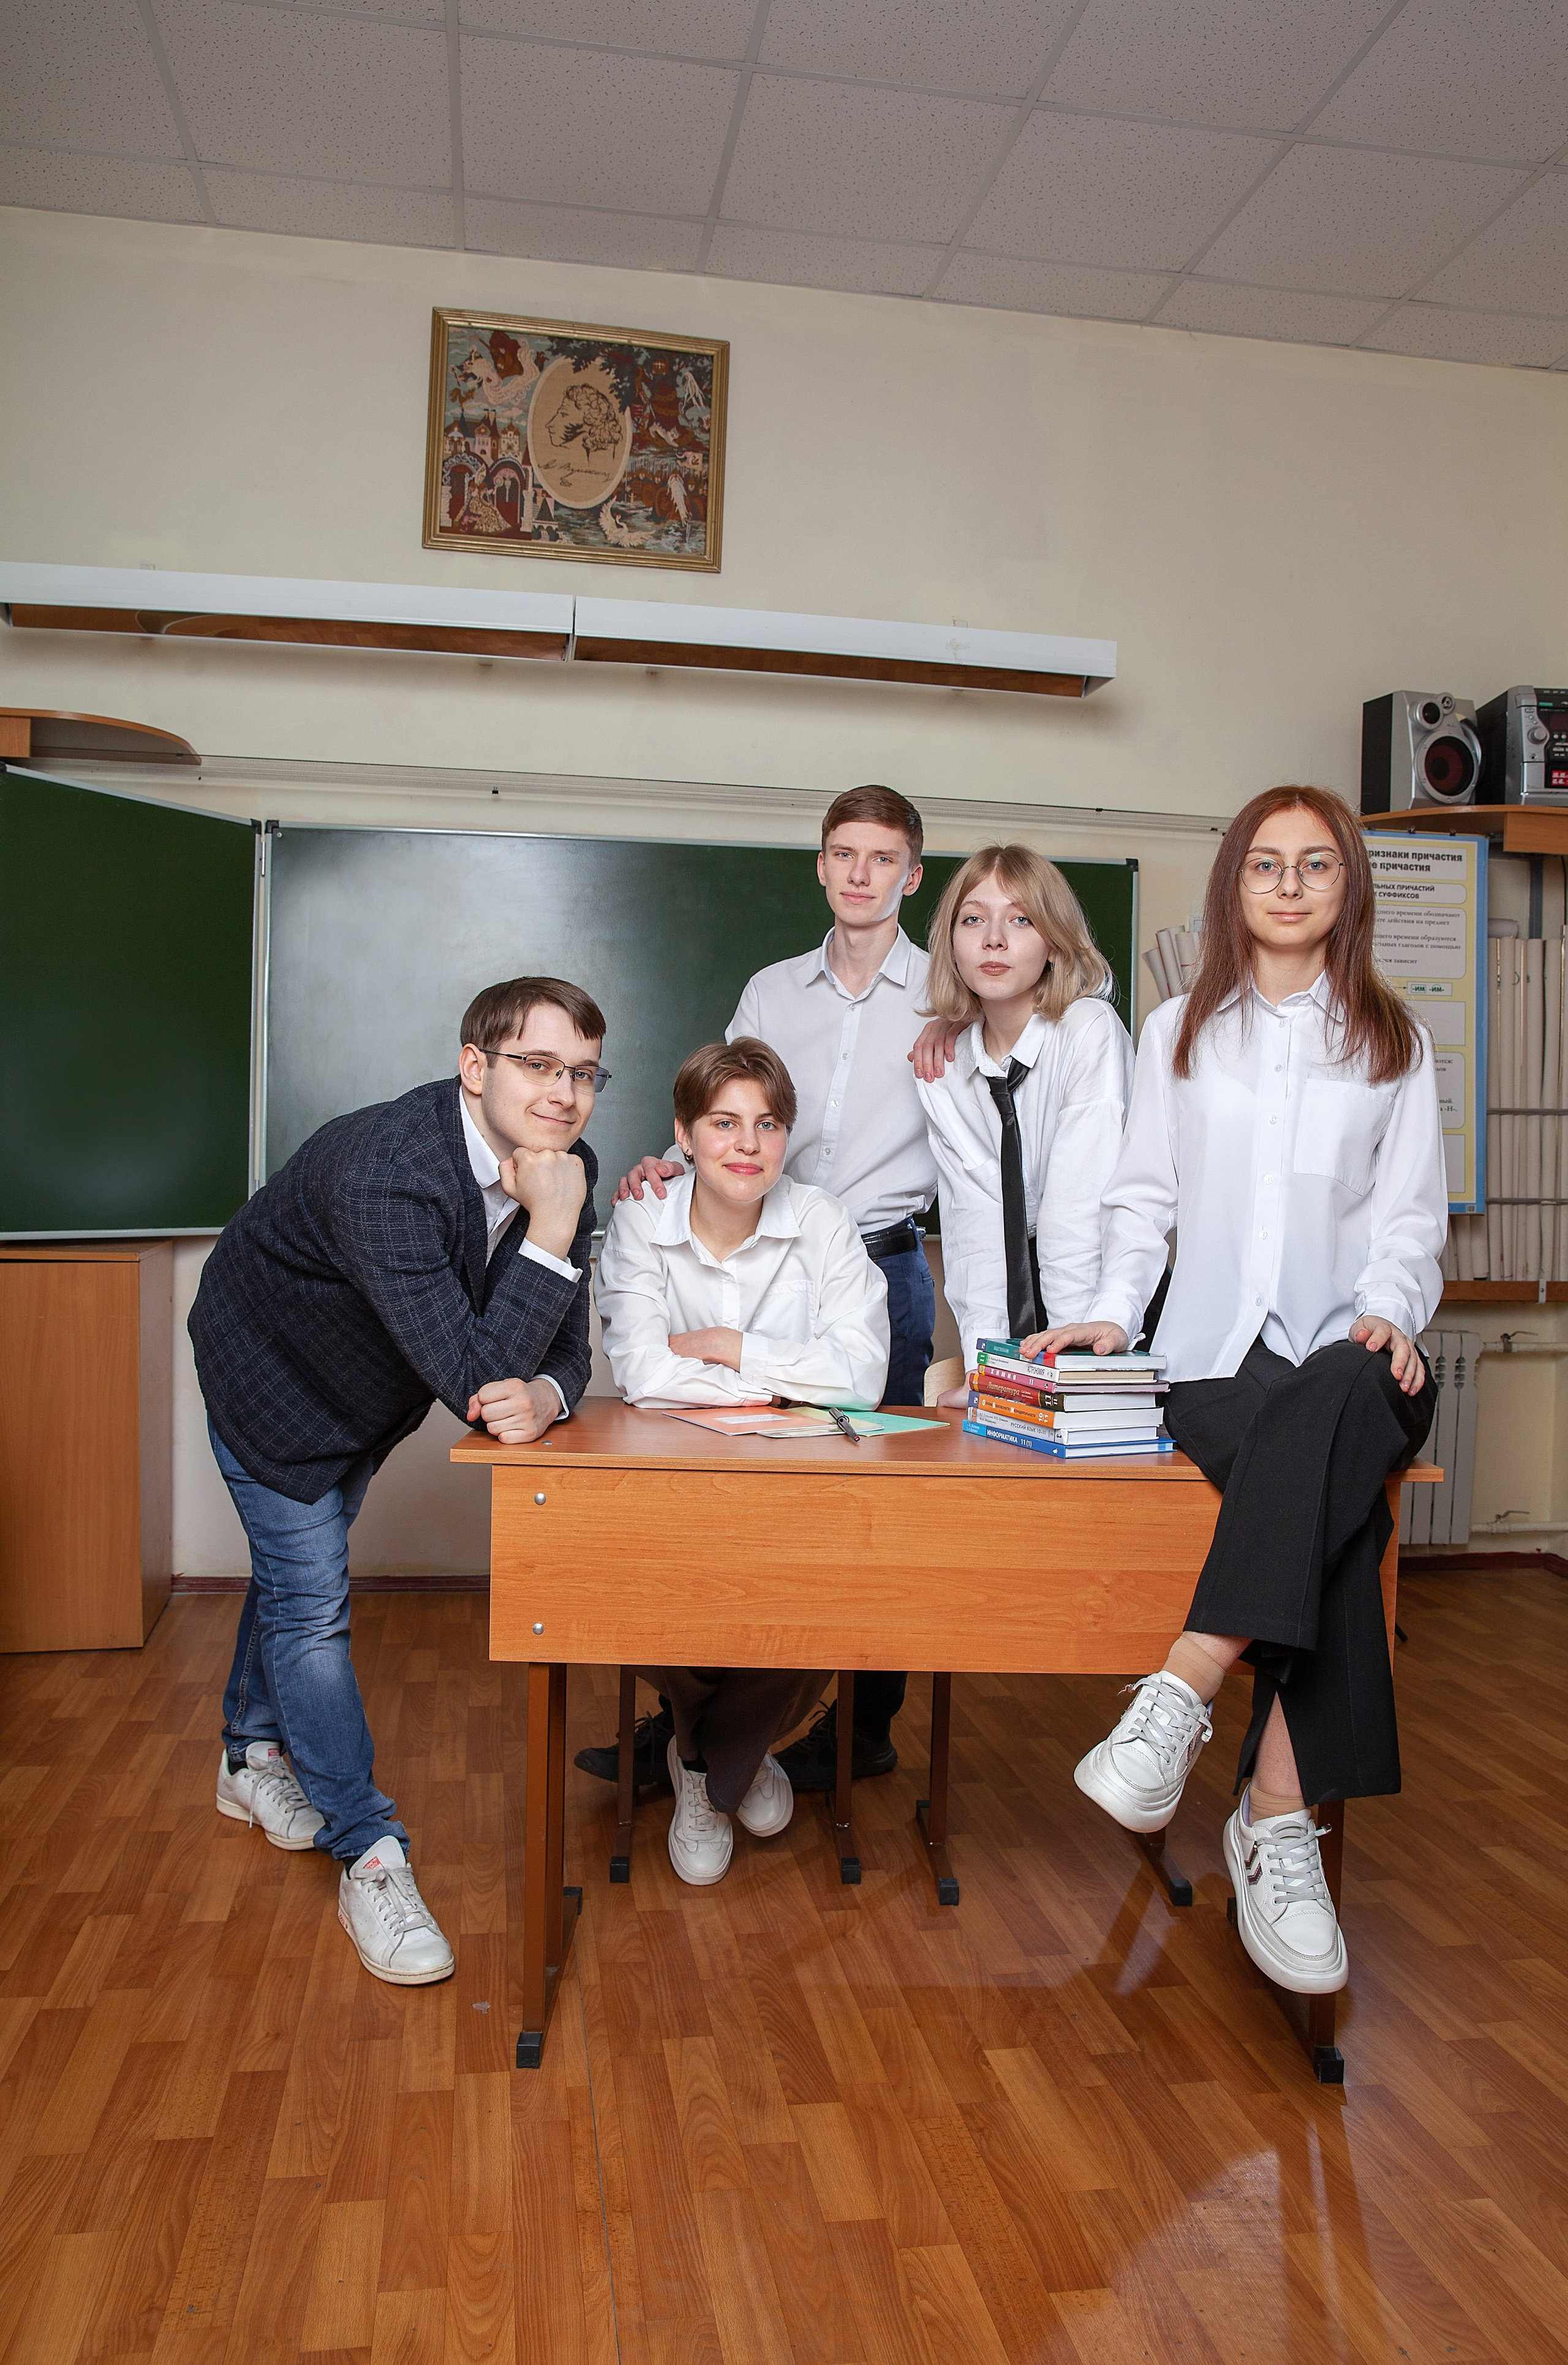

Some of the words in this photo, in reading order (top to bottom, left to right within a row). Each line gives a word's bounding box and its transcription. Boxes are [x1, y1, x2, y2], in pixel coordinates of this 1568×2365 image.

[1369, 850, 1409, 859] ризнаки
[1412, 851, 1463, 861] причастия
[1380, 862, 1431, 872] причастия
[990, 1368, 1016, 1380] ХИМИЯ
[1027, 1365, 1046, 1376] АСТРОНОМИЯ
[987, 1381, 1020, 1396] Литература
[1011, 1421, 1027, 1430] РУССКИЙ
[987, 1429, 1018, 1443] ИНФОРМАТИКА
